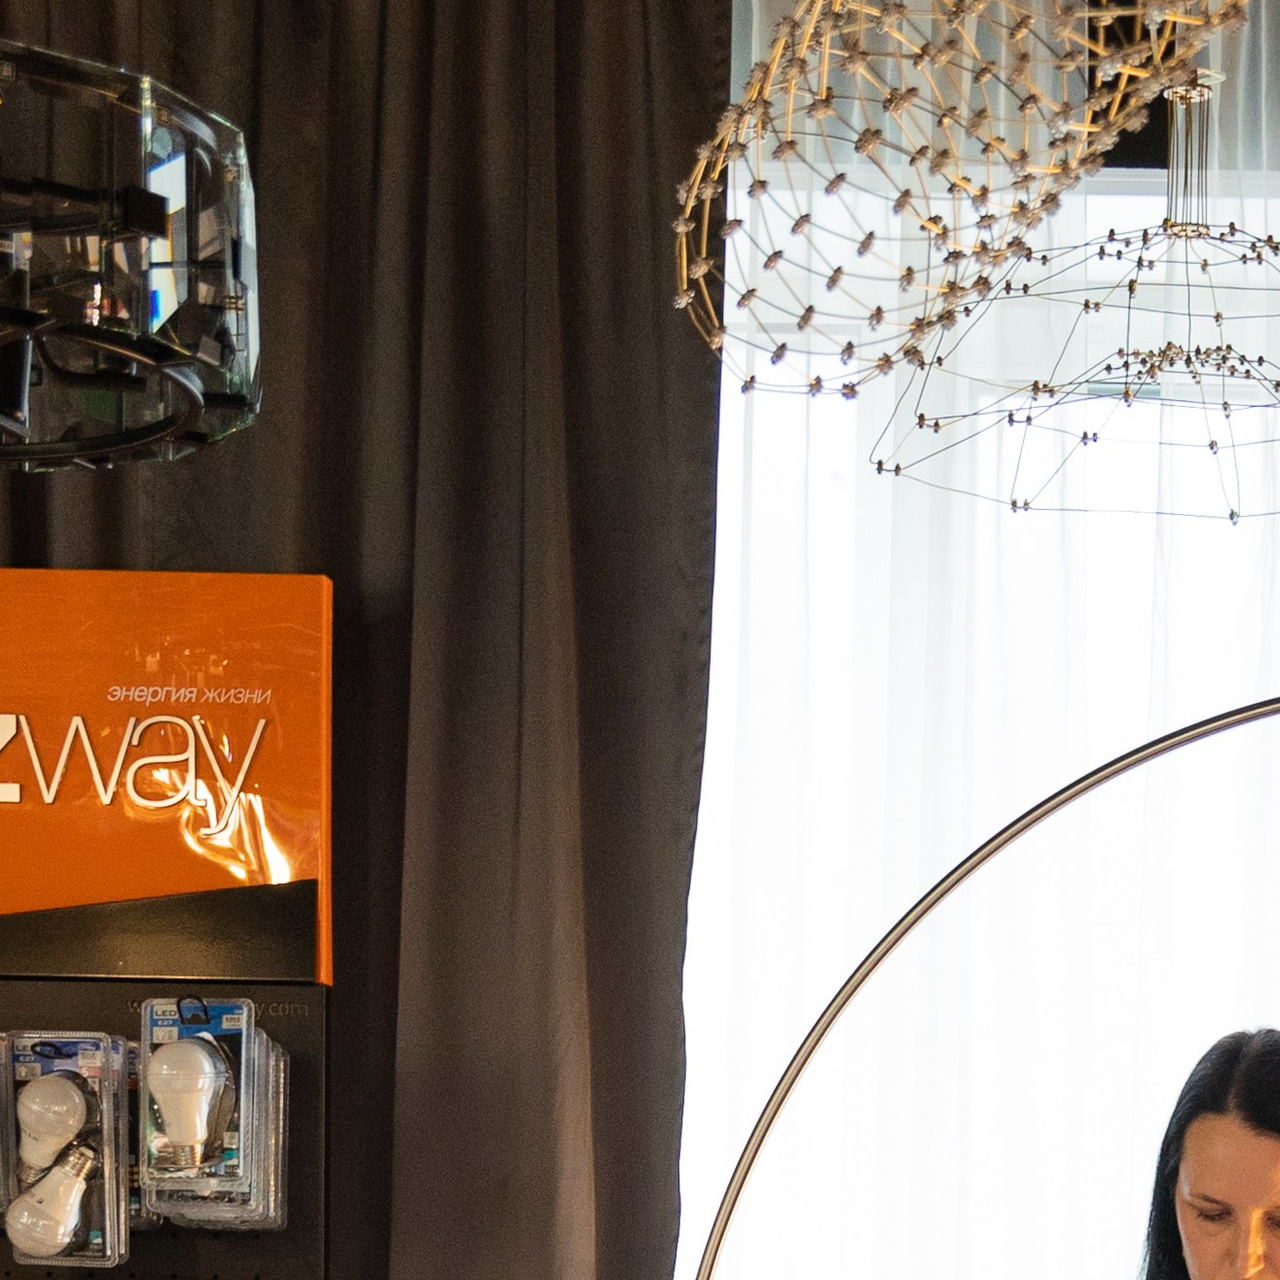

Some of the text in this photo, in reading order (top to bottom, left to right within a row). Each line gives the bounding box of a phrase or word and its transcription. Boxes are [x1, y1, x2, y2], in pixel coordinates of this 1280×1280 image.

[107, 685, 272, 707] энергия жизни
[0, 713, 267, 836] way
[155, 1009, 177, 1017] LED
